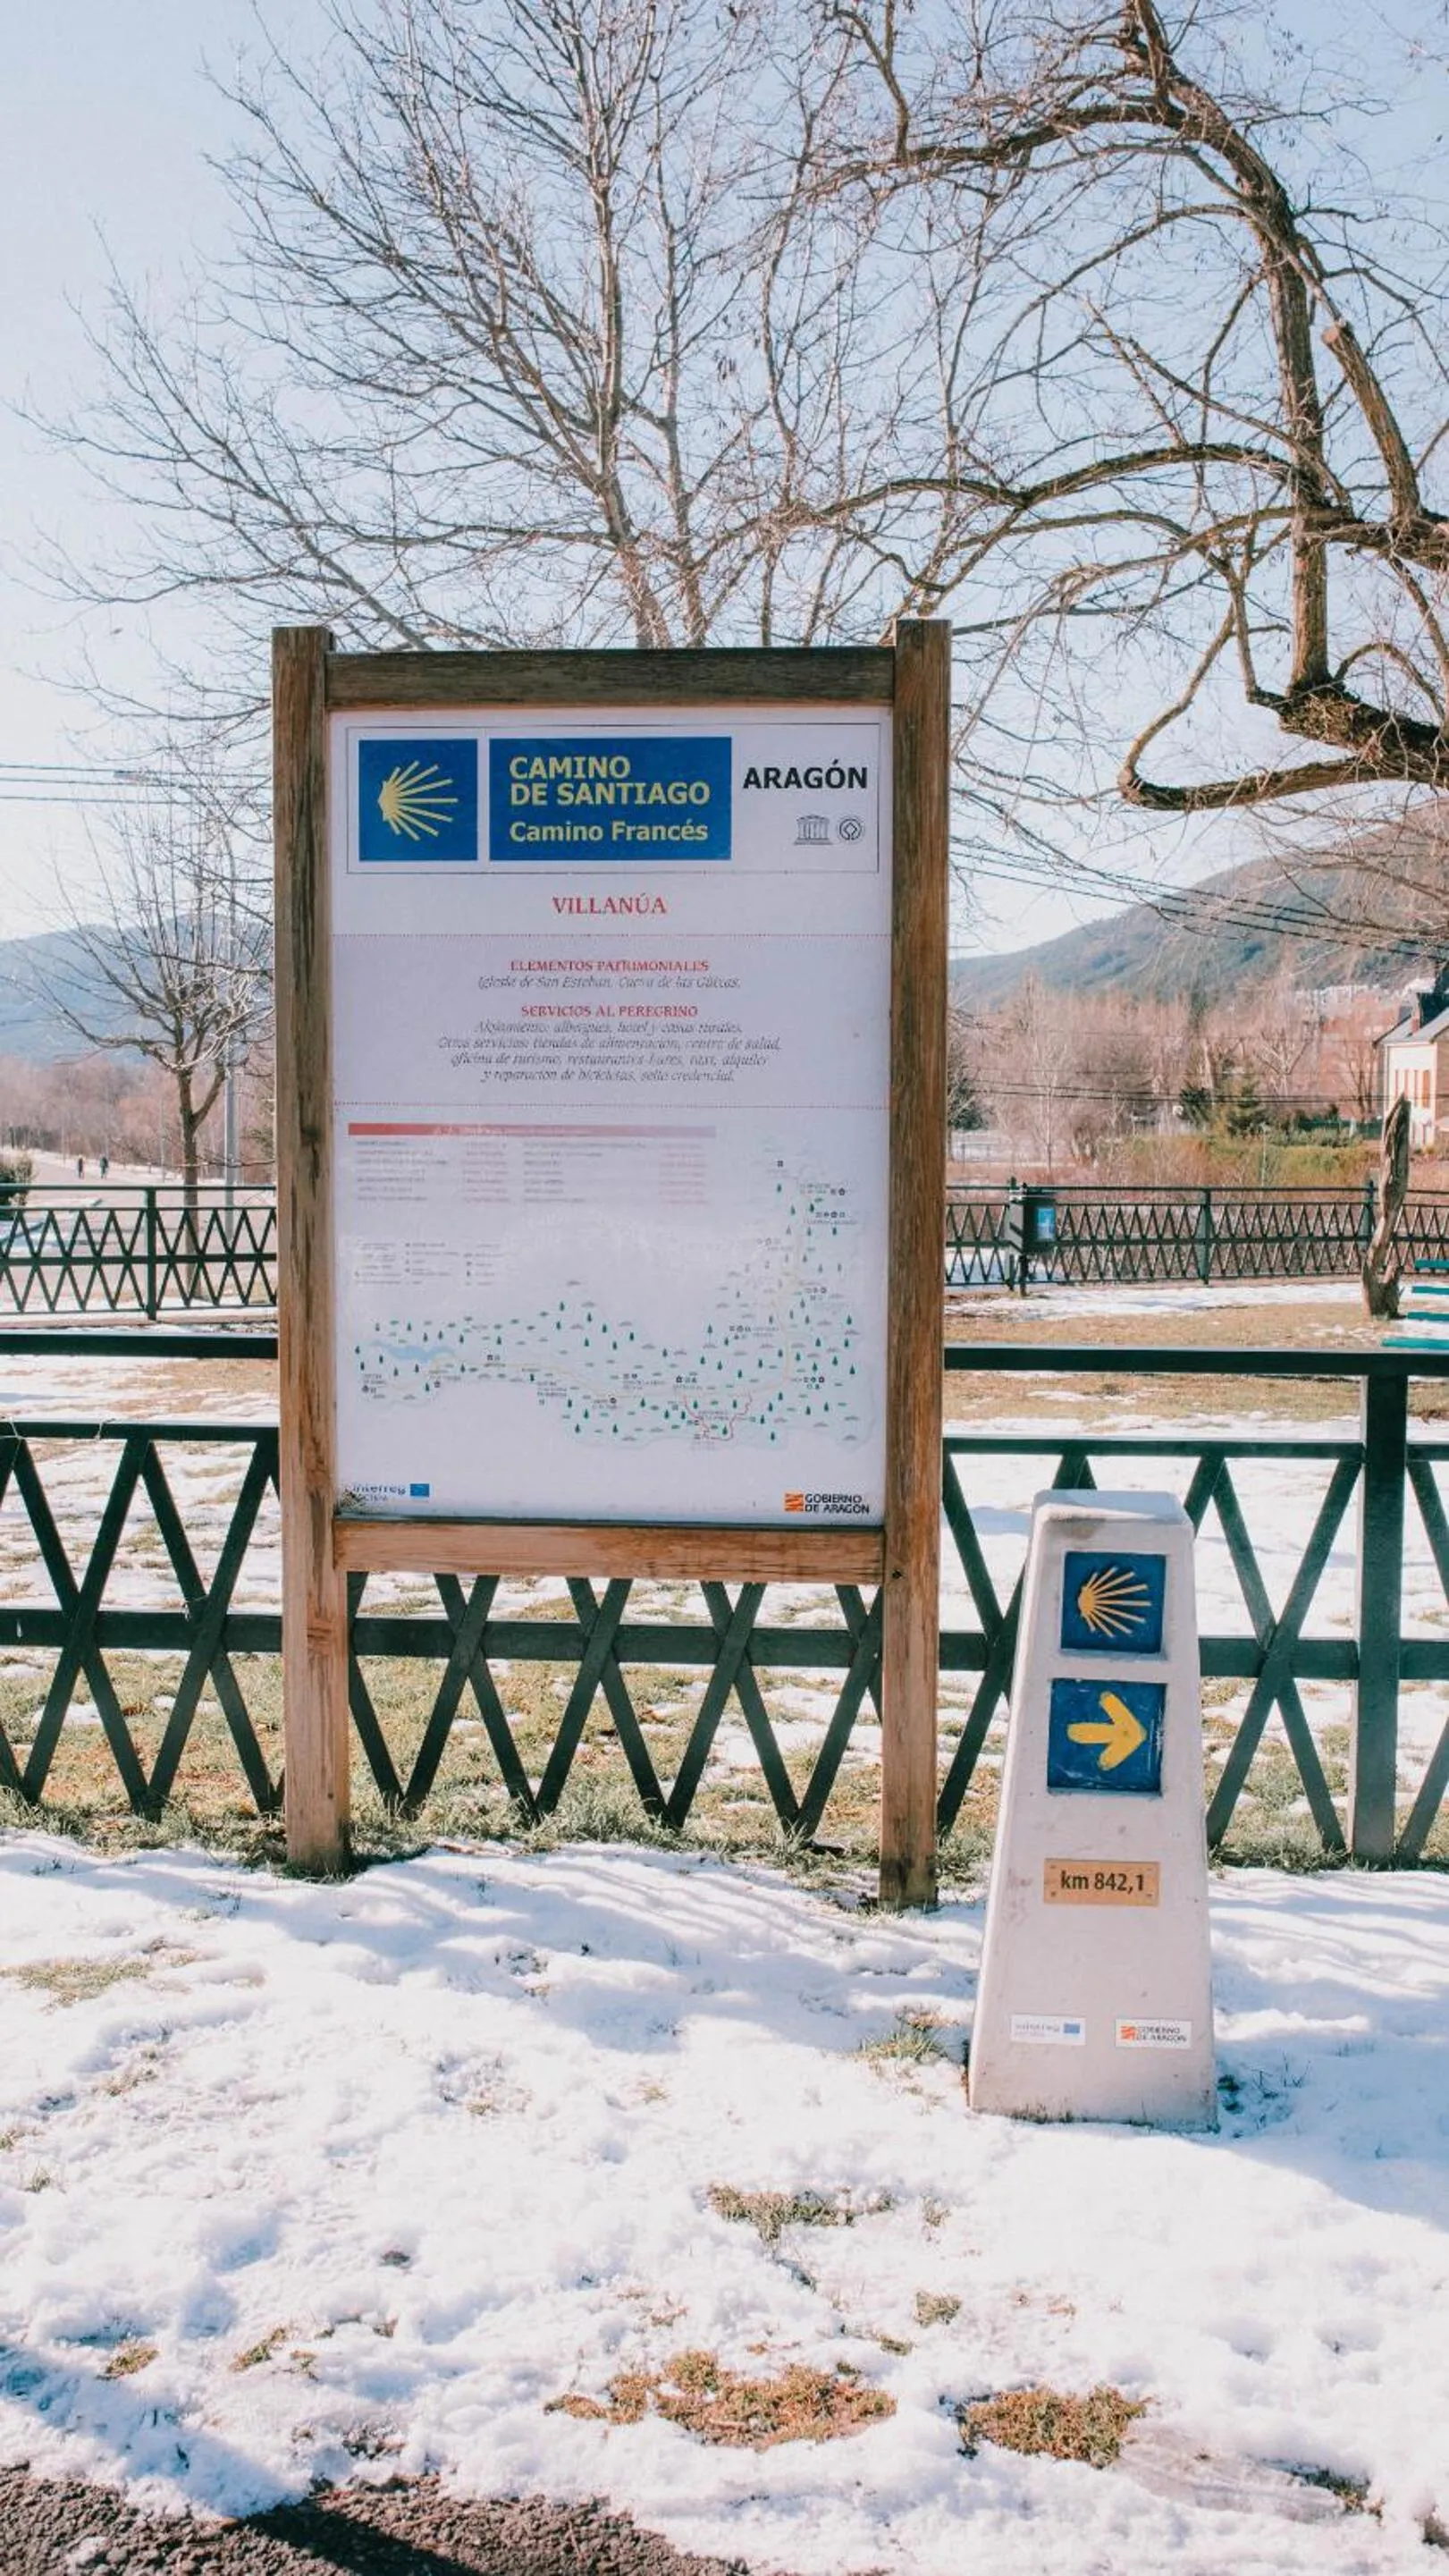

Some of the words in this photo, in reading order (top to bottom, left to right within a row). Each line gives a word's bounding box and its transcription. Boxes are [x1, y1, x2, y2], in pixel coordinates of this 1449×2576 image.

[509, 756, 631, 780] CAMINO
[743, 758, 868, 790] ARAGÓN
[510, 782, 548, 806] DE
[557, 781, 711, 806] SANTIAGO
[509, 820, 604, 842] Camino
[611, 818, 709, 841] Francés
[552, 893, 667, 915] VILLANÚA
[510, 959, 594, 972] ELEMENTOS
[597, 959, 710, 972] PATRIMONIALES
[521, 1005, 591, 1018] SERVICIOS
[595, 1005, 615, 1018] AL
[619, 1005, 698, 1018] PEREGRINO
[805, 1493, 863, 1503] GOBIERNO
[805, 1504, 820, 1513] DE
[1060, 1871, 1090, 1891] km
[1094, 1872, 1145, 1895] 842,1
